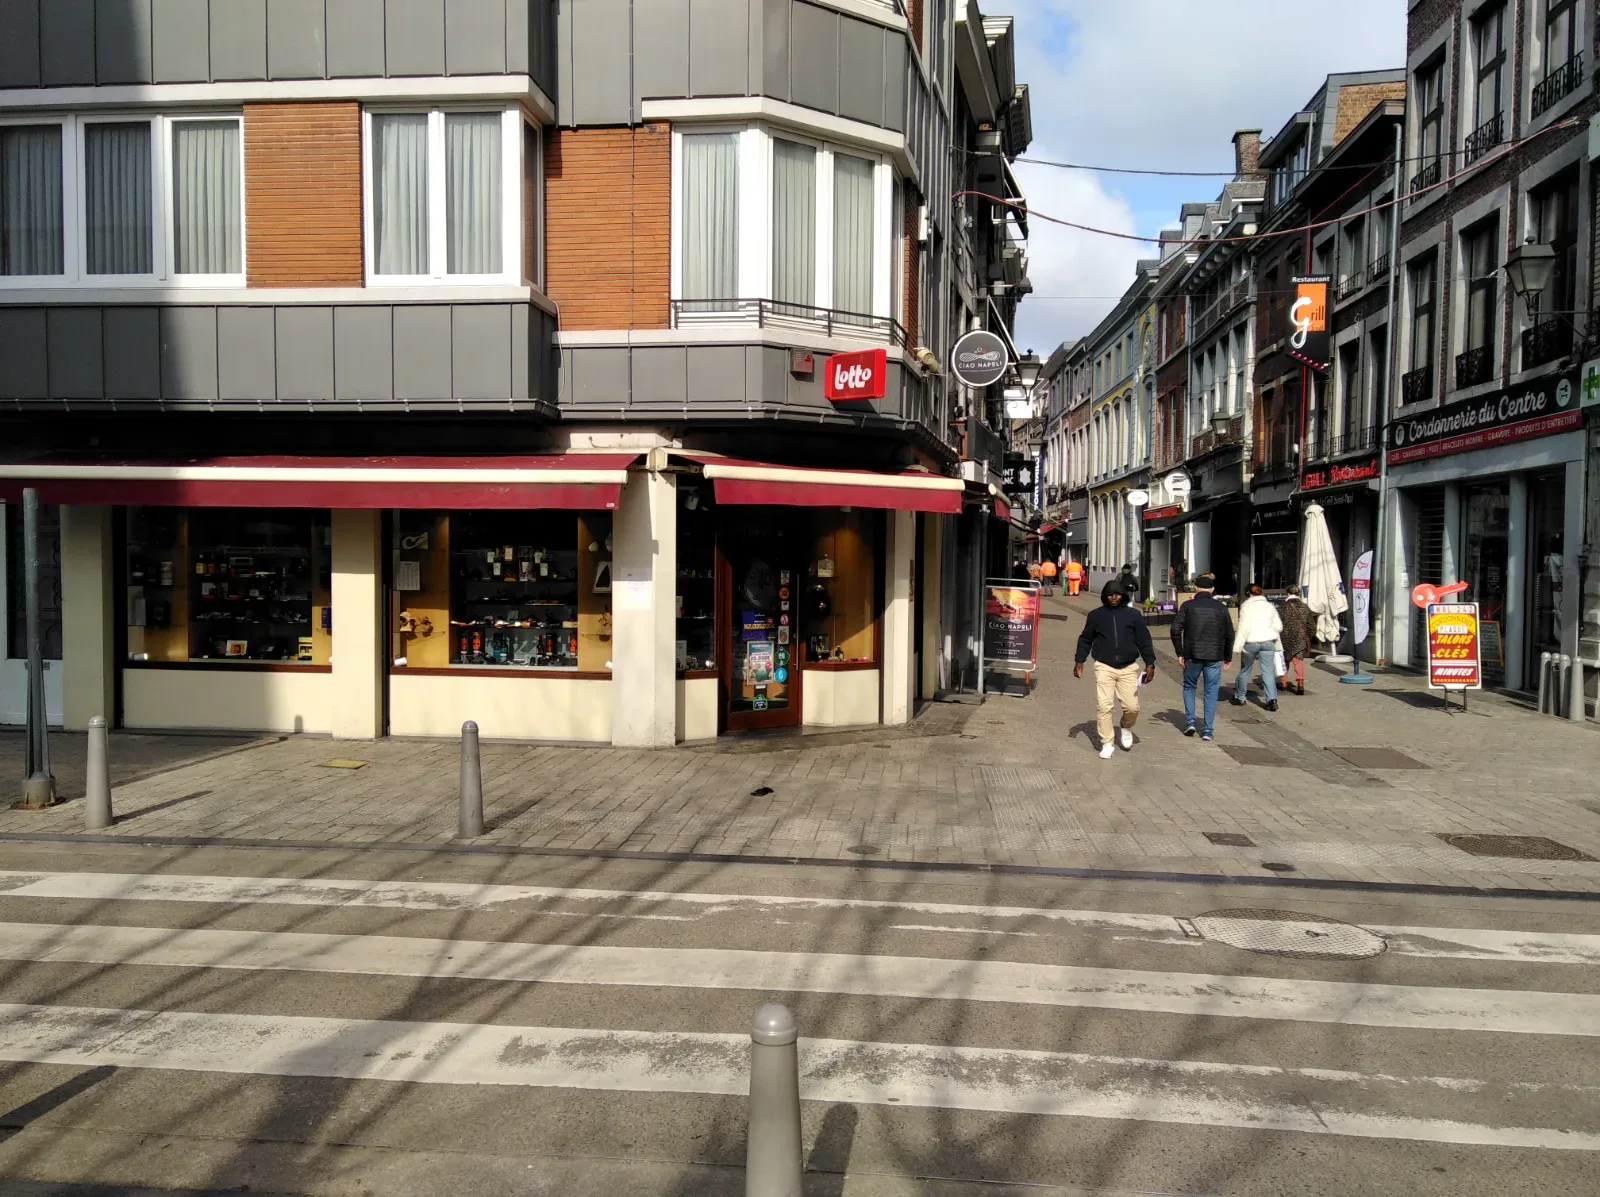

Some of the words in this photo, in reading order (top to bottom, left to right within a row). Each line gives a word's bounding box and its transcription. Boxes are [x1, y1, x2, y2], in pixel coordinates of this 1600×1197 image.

[1409, 405, 1477, 442] Cordonnerie
[1478, 402, 1497, 423] du
[1498, 390, 1547, 420] Centre
[1442, 439, 1464, 450] BRACELETS
[1465, 434, 1483, 446] MONTRE
[1488, 429, 1511, 441] GRAVURE
[1514, 422, 1540, 435] PRODUITS
[1541, 414, 1577, 430] D'ENTRETIEN
[1439, 625, 1467, 633] PLAQUE
[1436, 635, 1474, 644] TALONS
[1436, 645, 1469, 658] CLÉS
[1434, 667, 1474, 676] MINUTES
